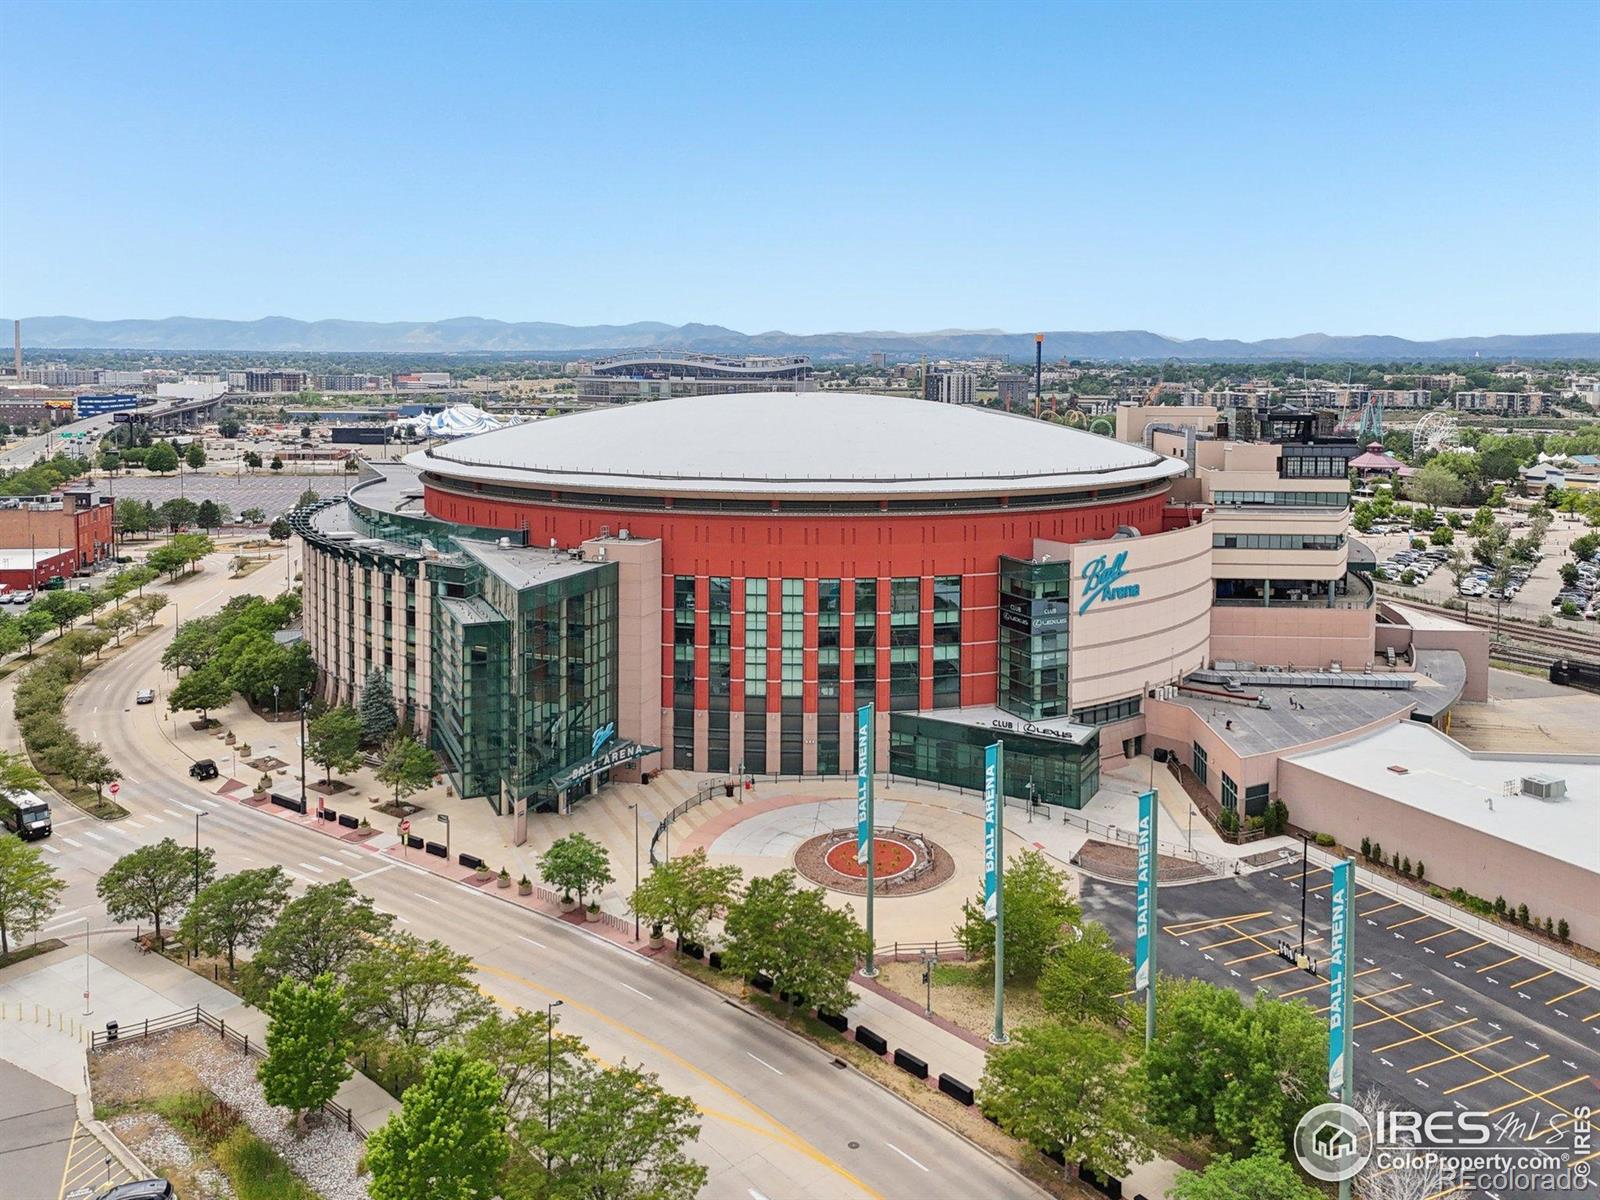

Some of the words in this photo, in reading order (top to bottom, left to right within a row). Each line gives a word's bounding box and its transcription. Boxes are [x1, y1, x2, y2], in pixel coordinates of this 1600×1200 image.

[1079, 550, 1129, 616] Ball
[1101, 583, 1140, 602] Arena
[858, 724, 868, 778] ARENA
[992, 719, 1013, 729] CLUB
[1036, 726, 1073, 738] LEXUS
[572, 760, 598, 779] BALL
[603, 744, 643, 765] ARENA
[858, 778, 868, 823] BALL
[985, 764, 995, 824] ARENA
[985, 828, 995, 874] BALL
[1138, 816, 1149, 880] ARENA
[1137, 886, 1149, 939] BALL
[1331, 888, 1346, 964] ARENA
[1331, 966, 1343, 1028] BALL
